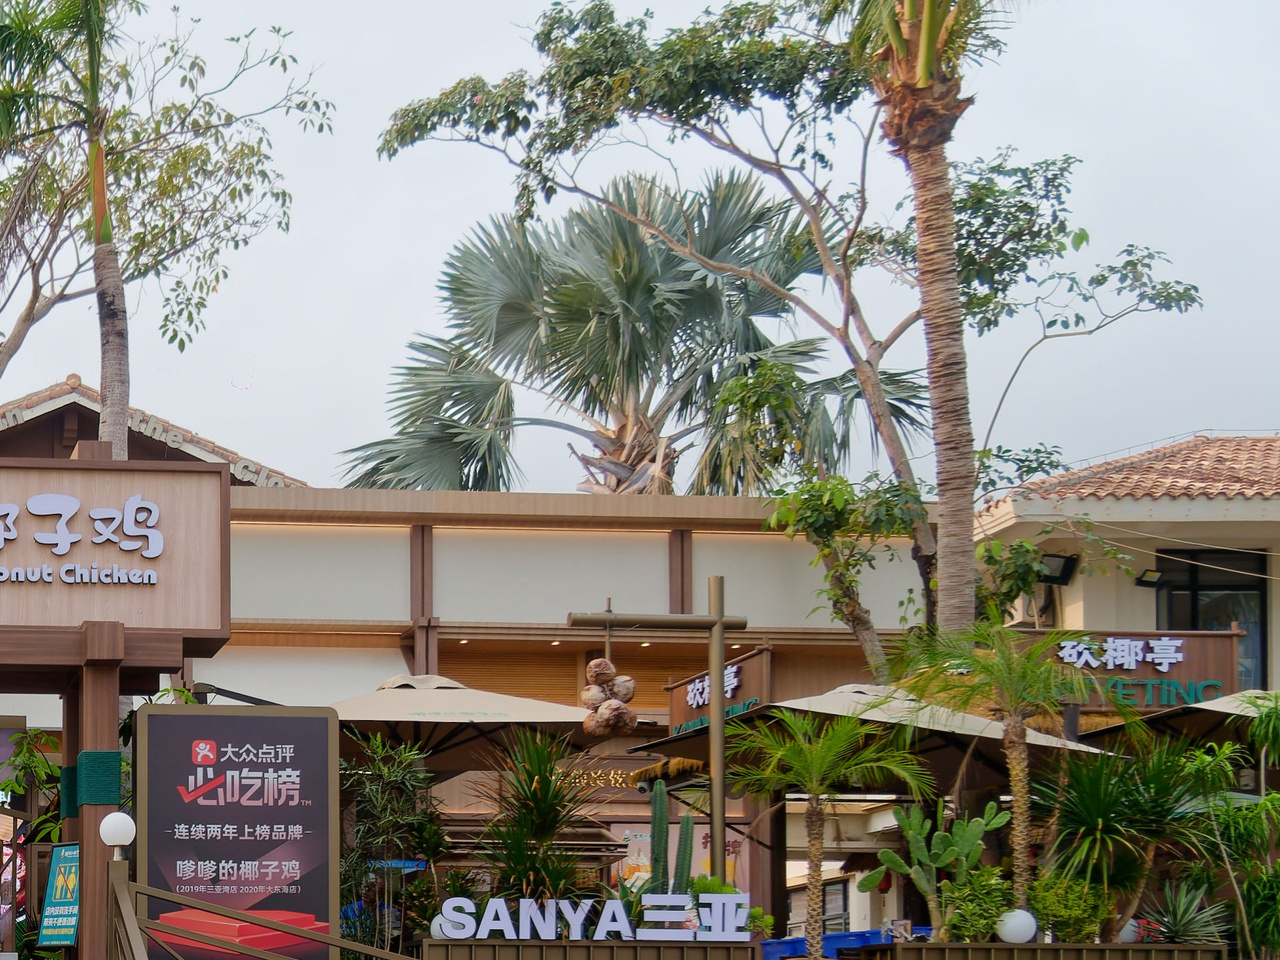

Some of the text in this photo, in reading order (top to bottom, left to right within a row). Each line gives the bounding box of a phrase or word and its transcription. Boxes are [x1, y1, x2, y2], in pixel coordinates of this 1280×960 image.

[129, 408, 185, 450] the
[59, 562, 158, 585] Chicken
[1058, 636, 1184, 673] 砍椰亭
[220, 743, 295, 763] 大众点评
[177, 767, 301, 807] 必吃榜
[173, 823, 304, 841] 连续两年上榜品牌
